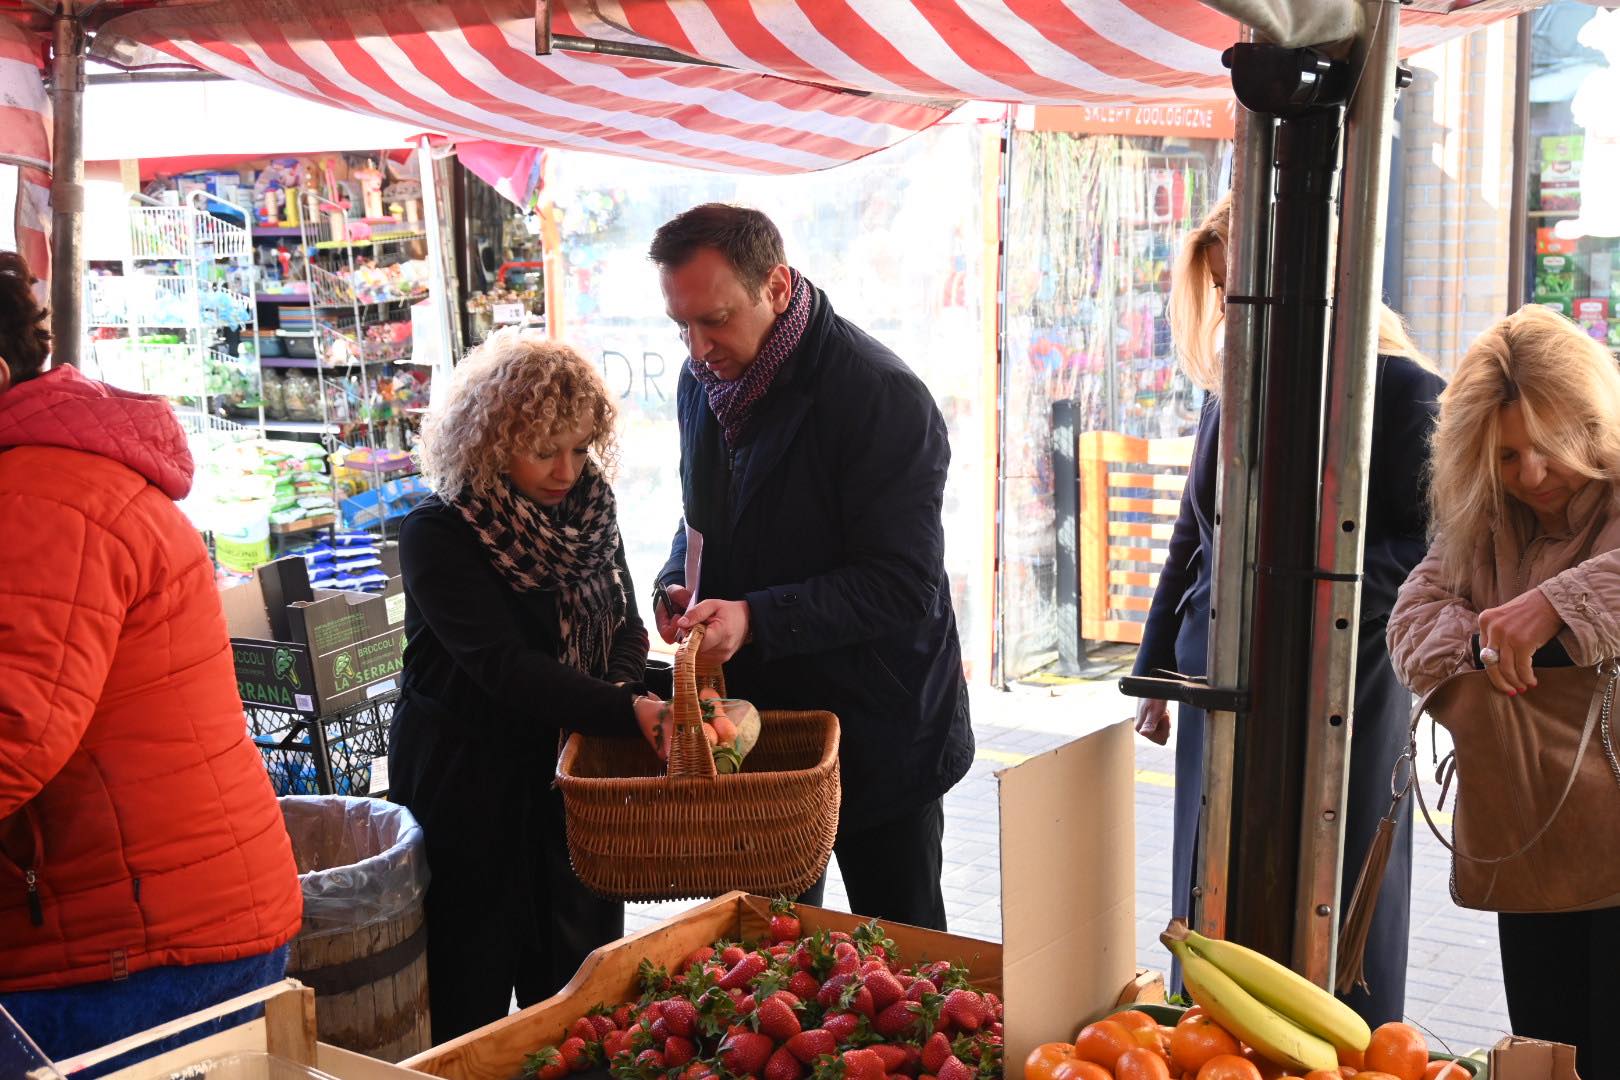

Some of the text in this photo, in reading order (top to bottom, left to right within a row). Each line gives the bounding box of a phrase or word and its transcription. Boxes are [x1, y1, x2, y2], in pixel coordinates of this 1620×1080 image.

[1135, 105, 1213, 129] ZOOLOGICZNE
[602, 350, 667, 402] DR
[357, 637, 395, 658] BROCCOLI
[334, 677, 350, 692] LA
